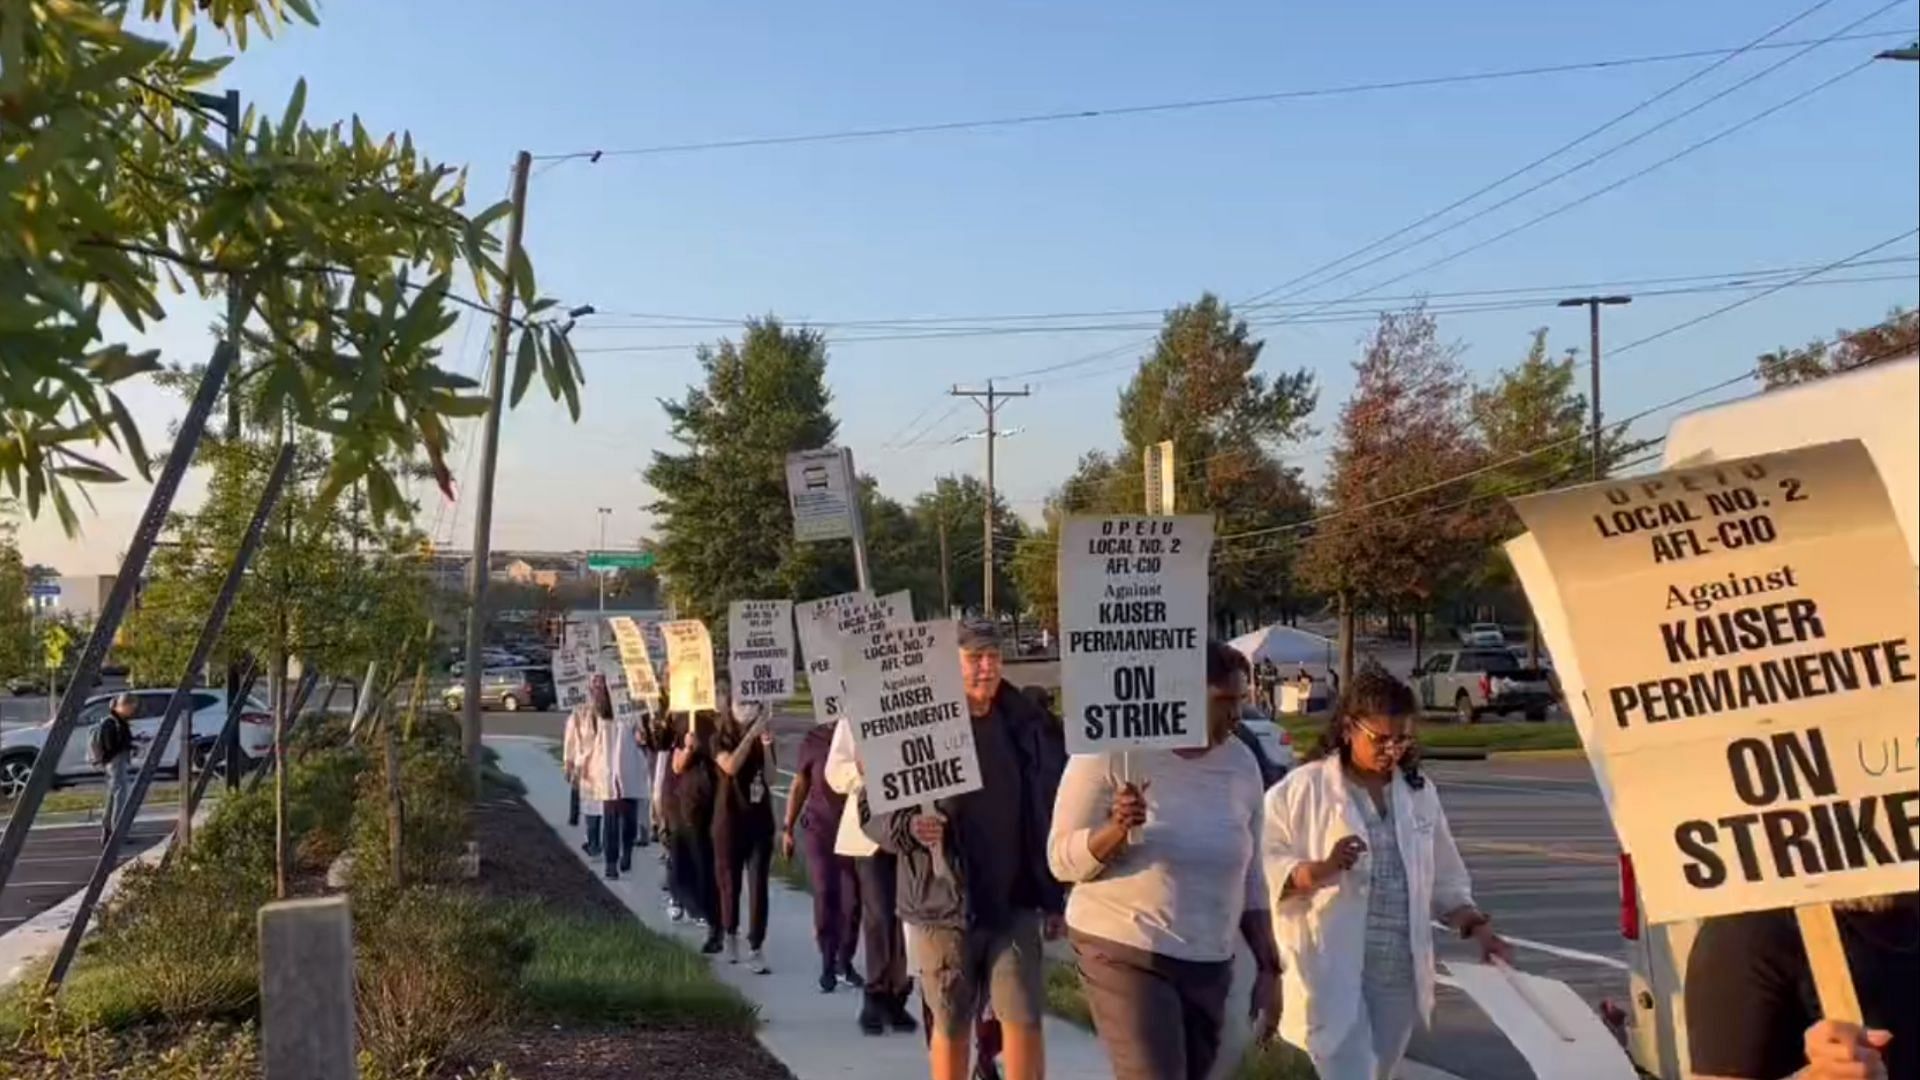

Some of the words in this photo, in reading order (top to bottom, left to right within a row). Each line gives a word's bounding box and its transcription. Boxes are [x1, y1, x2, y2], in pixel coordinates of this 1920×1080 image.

[1593, 499, 1702, 537] LOCAL
[1705, 487, 1770, 516] NO.
[1779, 477, 1809, 502] 2
[1089, 538, 1134, 555] LOCAL
[1138, 538, 1165, 555] NO.
[1171, 538, 1181, 554] 2
[1651, 514, 1776, 563] AFL-CIO
[1105, 557, 1161, 574] AFL-CIO
[1104, 583, 1162, 600] Against
[1665, 564, 1798, 613] Against
[1099, 601, 1167, 624] KAISER
[1070, 627, 1197, 653] PERMANENTE
[1660, 598, 1825, 663] KAISER
[864, 643, 901, 660] LOCAL
[903, 638, 923, 652] NO.
[881, 653, 923, 672] AFL-CIO
[741, 679, 785, 696] STRIKE
[753, 663, 772, 680] ON
[882, 674, 926, 691] Against
[1113, 665, 1155, 701] ON
[1609, 638, 1916, 728] PERMANENTE
[880, 686, 934, 713] KAISER
[861, 700, 961, 739] PERMANENTE
[1084, 701, 1187, 741] STRIKE
[902, 734, 935, 767] ON
[1726, 728, 1837, 807] ON
[1858, 737, 1919, 777] UL
[882, 757, 966, 800] STRIKE
[1674, 791, 1919, 889] STRIKE
